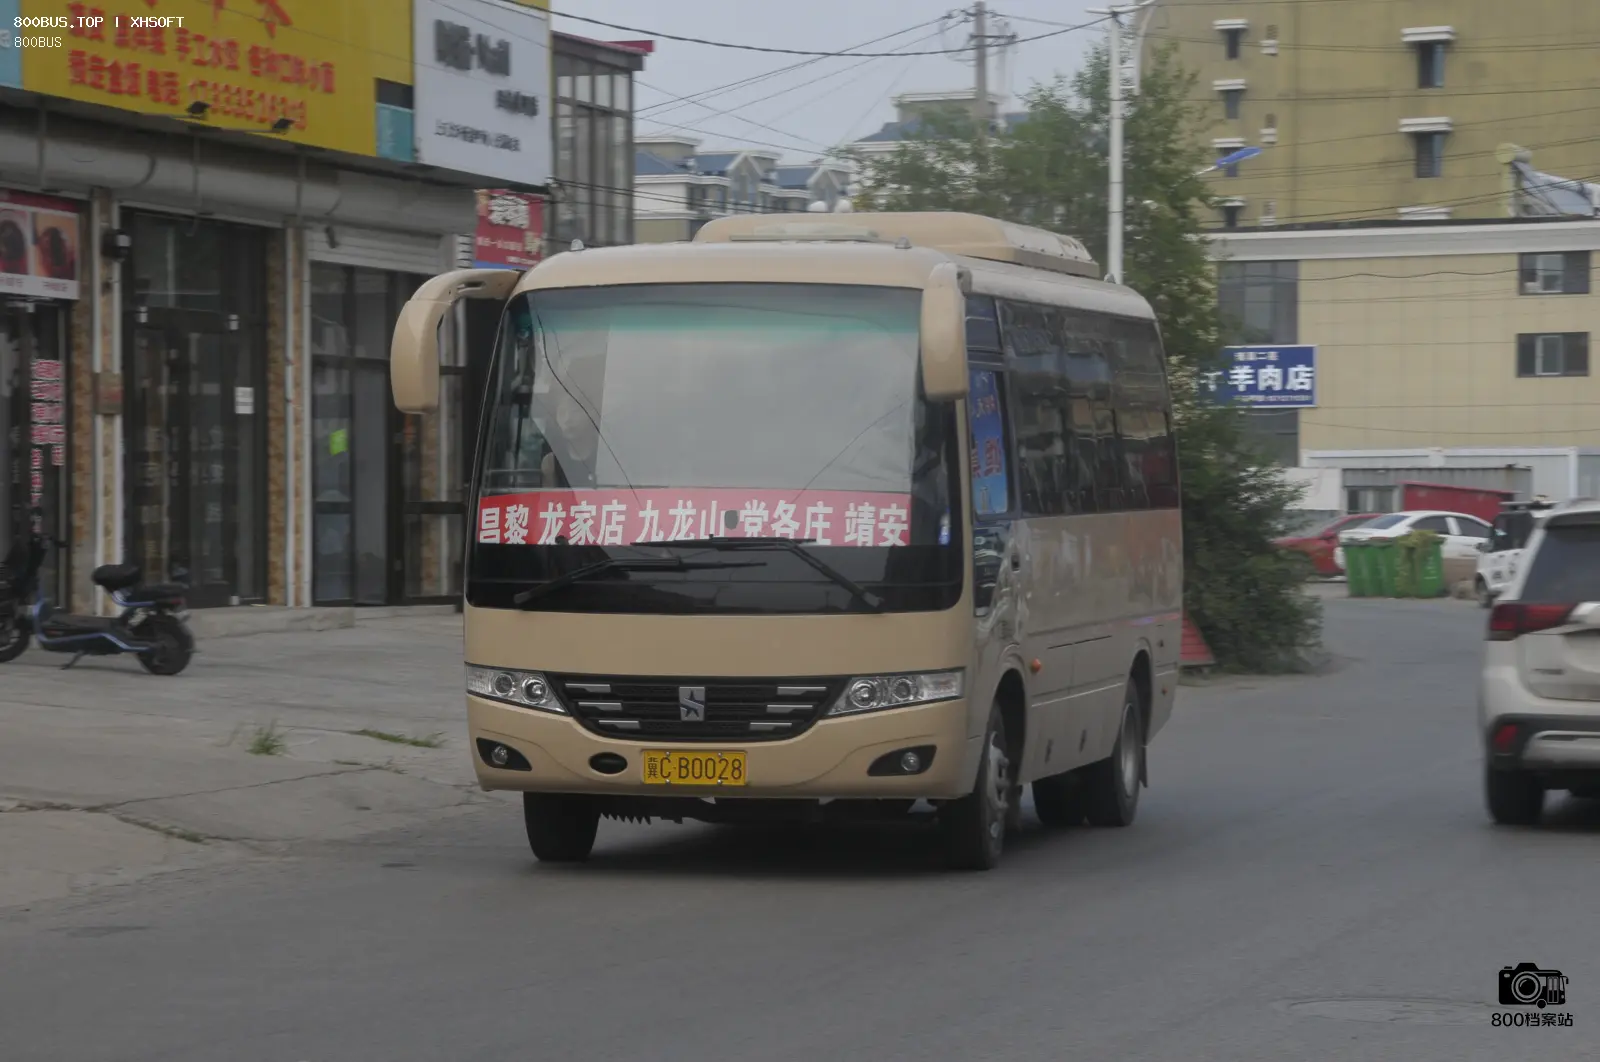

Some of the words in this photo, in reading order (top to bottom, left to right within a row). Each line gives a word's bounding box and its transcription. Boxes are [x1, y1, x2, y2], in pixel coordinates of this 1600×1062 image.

[479, 504, 530, 545] 昌黎
[537, 499, 627, 546] 龙家店
[635, 499, 726, 543] 九龙山
[739, 499, 834, 546] 党各庄
[844, 501, 909, 547] 靖安
